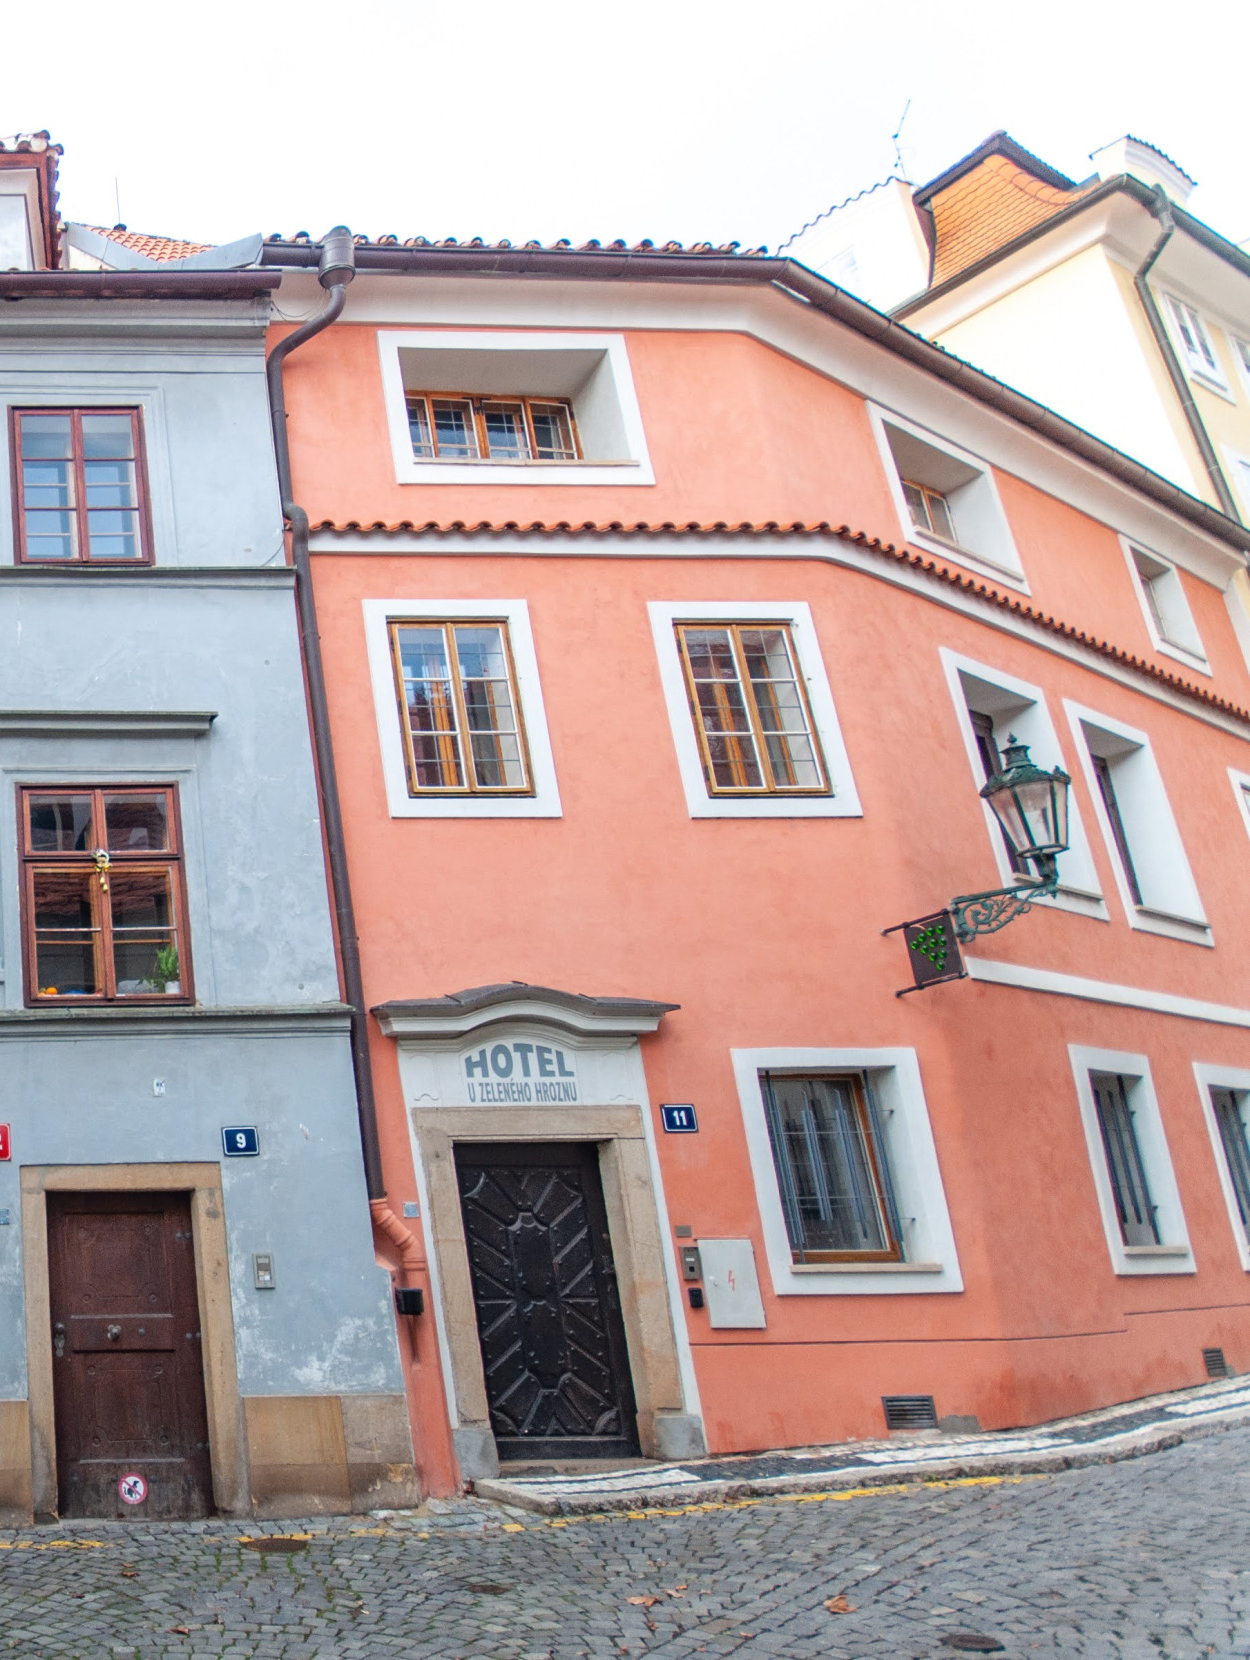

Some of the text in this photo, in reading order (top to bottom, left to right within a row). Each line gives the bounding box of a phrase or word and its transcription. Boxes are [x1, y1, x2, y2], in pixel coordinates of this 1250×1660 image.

[465, 1043, 575, 1078] HOTEL
[468, 1078, 578, 1103] U ZELENÉHO HROZNU
[672, 1110, 688, 1126] 11
[235, 1132, 247, 1149] 9
